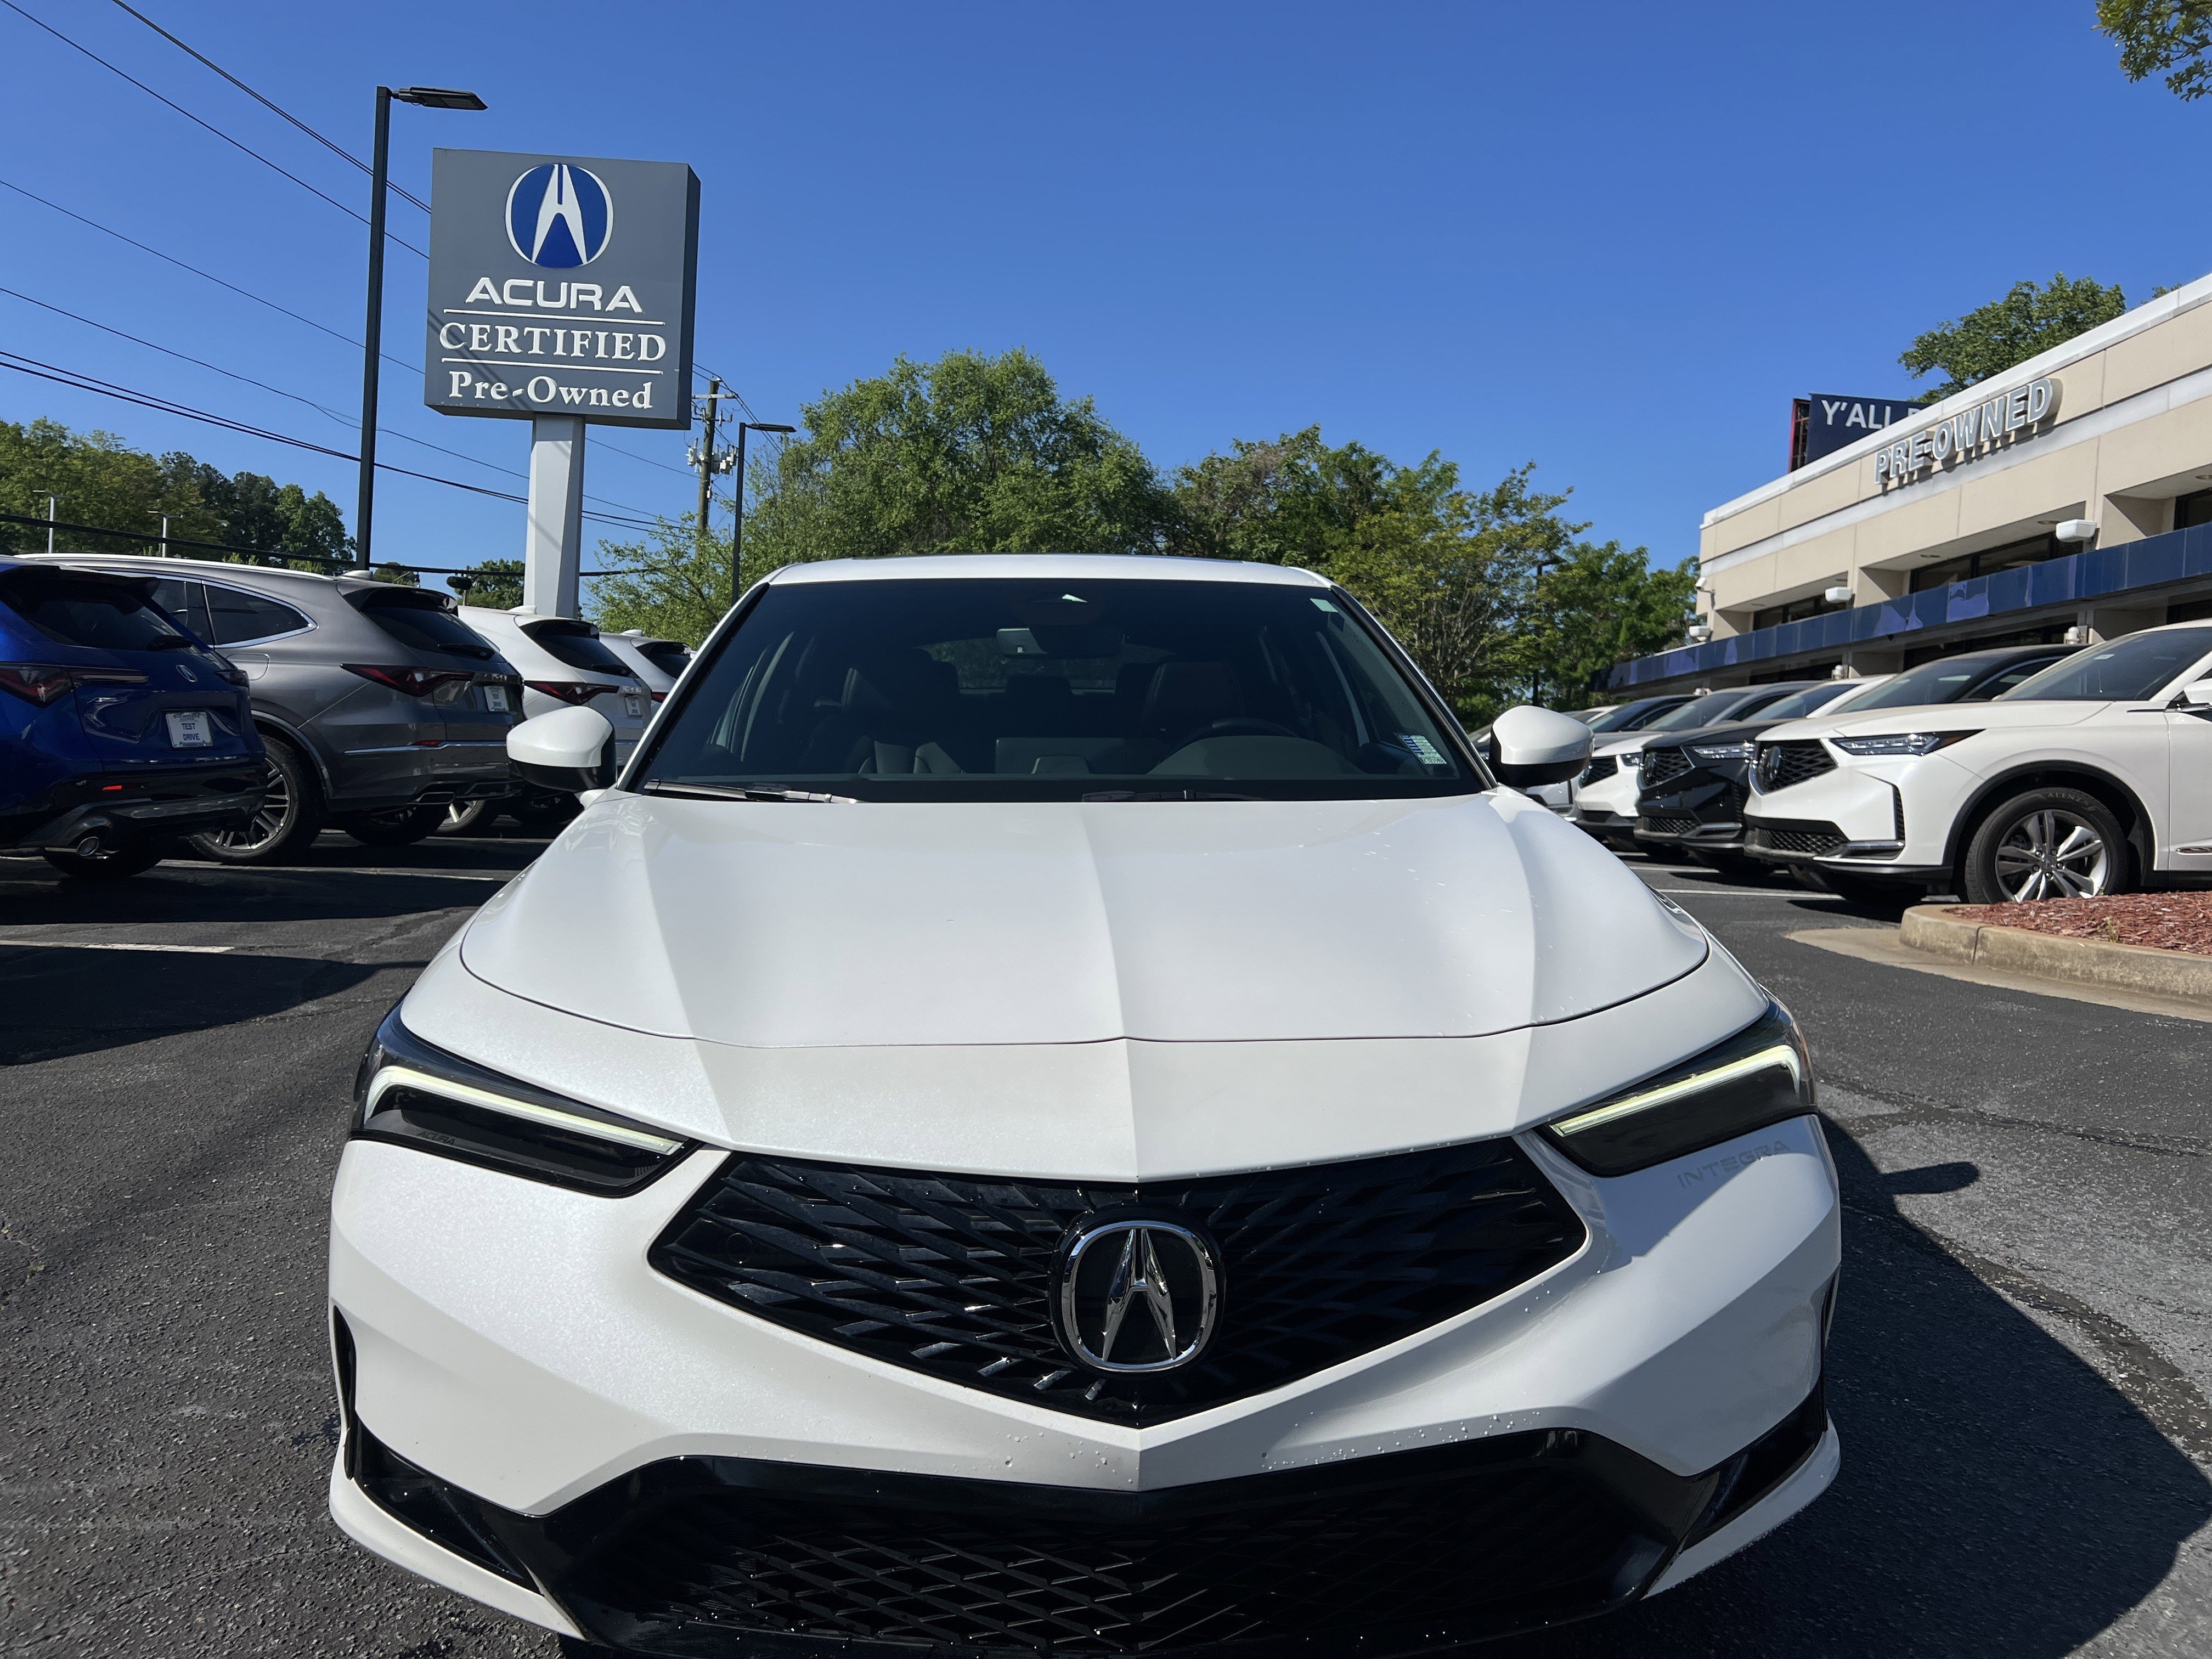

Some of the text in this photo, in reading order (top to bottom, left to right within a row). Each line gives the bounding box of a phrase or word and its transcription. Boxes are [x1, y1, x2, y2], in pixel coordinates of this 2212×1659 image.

[466, 277, 644, 313] ACURA
[439, 322, 667, 362] CERTIFIED
[449, 371, 653, 409] Pre-Owned
[1874, 377, 2055, 485] PRE-OWNED
[417, 1131, 455, 1146] ACURA
[1677, 1140, 1790, 1188] INTEGRA
